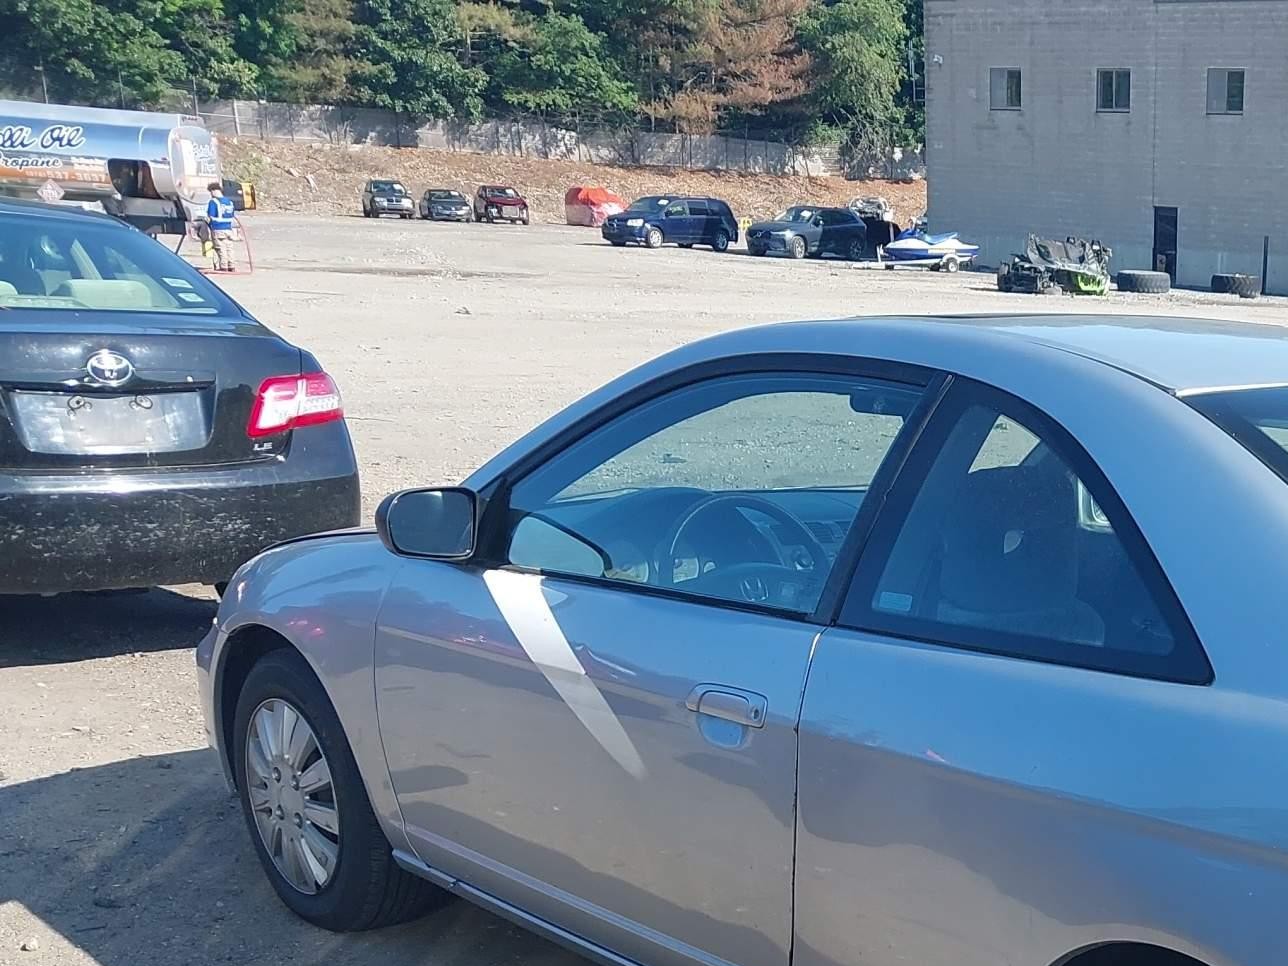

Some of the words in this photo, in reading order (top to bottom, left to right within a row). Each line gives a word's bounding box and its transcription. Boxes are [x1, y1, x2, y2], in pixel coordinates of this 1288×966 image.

[0, 125, 37, 149] lli
[40, 125, 86, 149] Oil
[0, 151, 62, 170] ropane
[253, 442, 273, 451] LE
